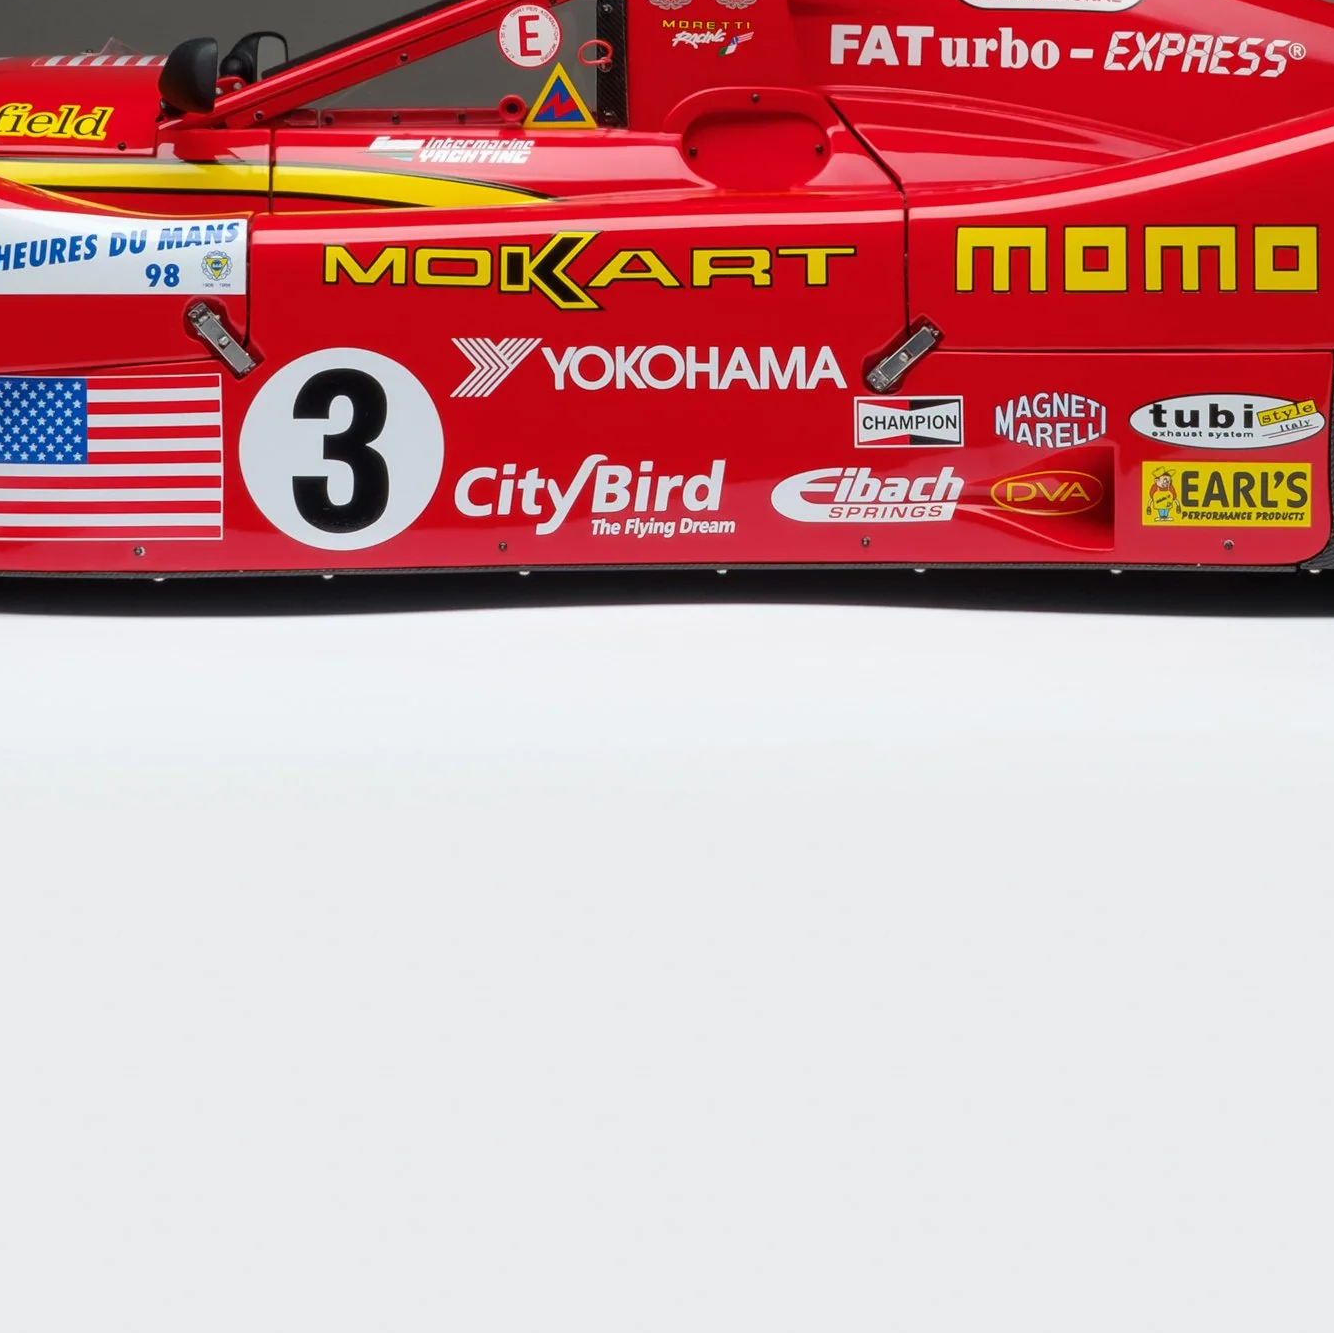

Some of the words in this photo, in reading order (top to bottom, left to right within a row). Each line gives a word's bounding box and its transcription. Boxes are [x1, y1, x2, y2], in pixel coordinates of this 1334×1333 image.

[518, 14, 542, 57] E
[662, 20, 751, 29] MORETTI
[419, 149, 532, 164] YACHTING
[109, 229, 148, 257] DU
[157, 222, 239, 251] MANS
[145, 263, 180, 288] 98
[541, 345, 848, 391] YOKOHAMA
[862, 412, 958, 431] CHAMPION
[995, 392, 1107, 433] MAGNETI
[1149, 403, 1254, 428] tubi
[1261, 401, 1314, 425] style
[995, 408, 1107, 448] MARELLI
[1151, 430, 1203, 438] exhaust
[1208, 430, 1254, 439] system
[292, 368, 389, 535] 3
[771, 467, 965, 507] Eibach
[1005, 481, 1092, 502] DVA
[1181, 470, 1308, 509] EARL'S
[827, 505, 943, 519] SPRINGS
[1181, 511, 1252, 521] PERFORMANCE
[1255, 512, 1305, 521] PRODUCTS
[591, 518, 622, 535] The
[624, 518, 676, 540] Flying
[679, 518, 736, 535] Dream
